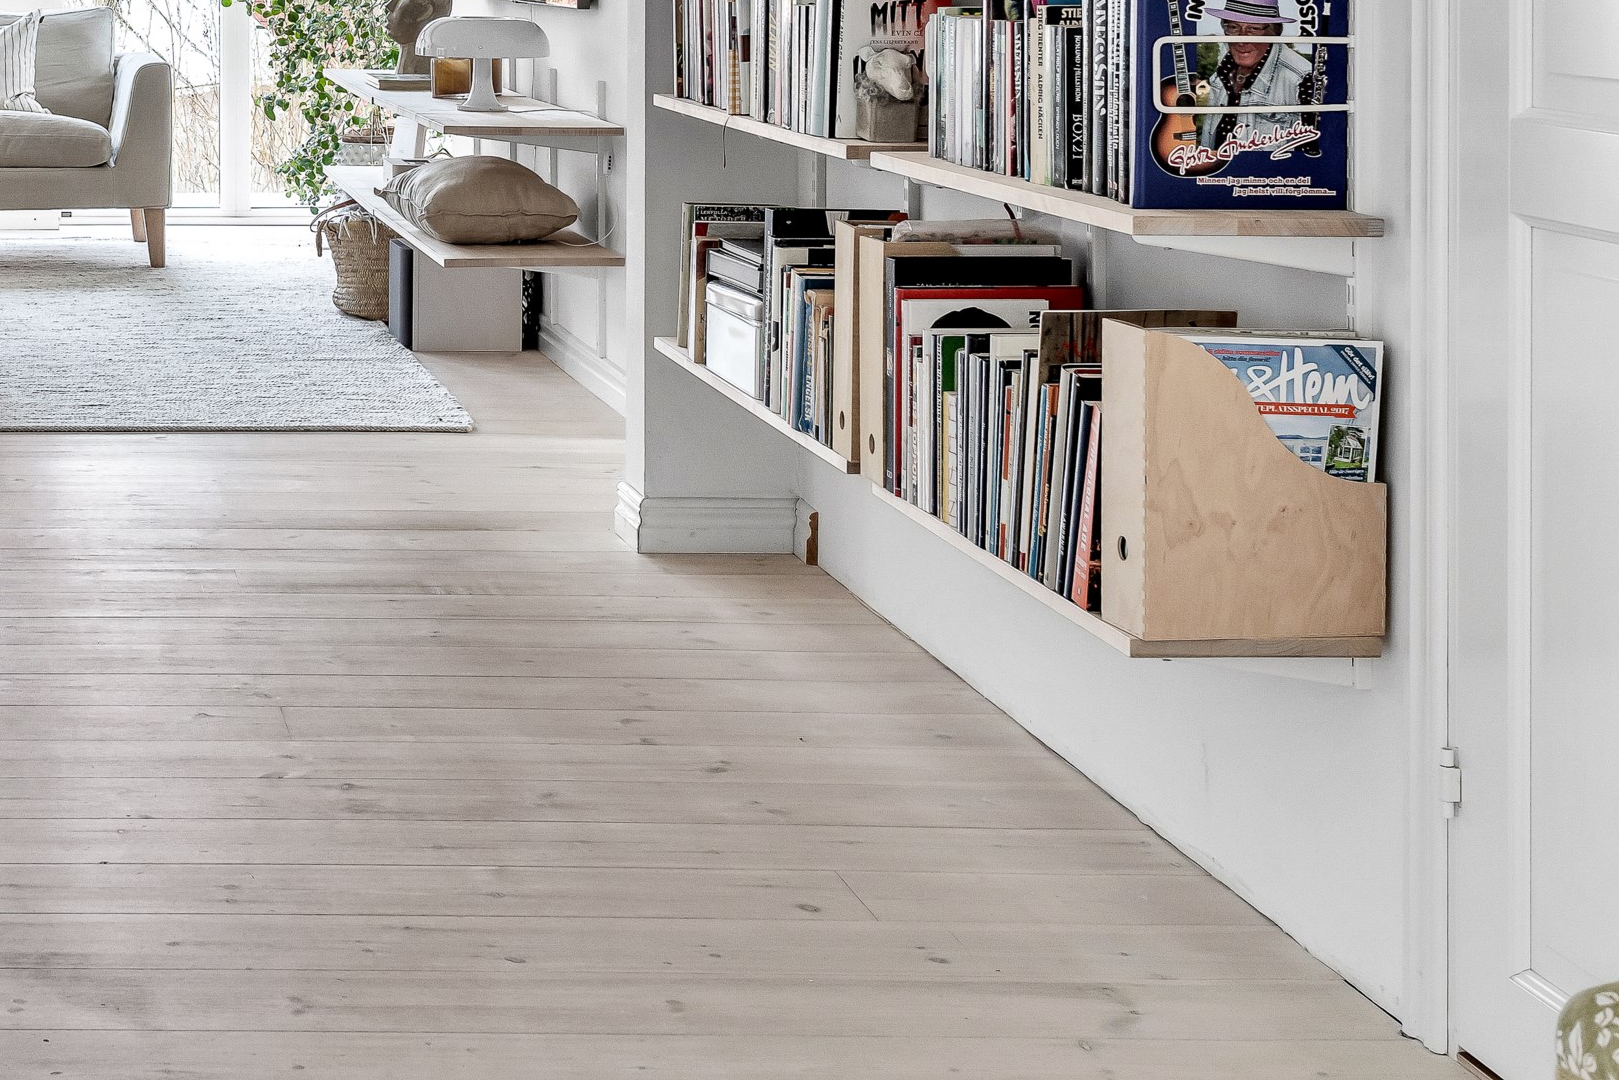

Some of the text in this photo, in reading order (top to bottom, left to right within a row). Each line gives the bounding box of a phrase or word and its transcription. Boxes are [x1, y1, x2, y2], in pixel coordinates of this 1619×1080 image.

[1061, 8, 1082, 18] STIE
[769, 13, 777, 71] ZLATAN
[1072, 114, 1082, 141] BOX
[1072, 144, 1082, 160] 21
[1197, 177, 1226, 185] Minnen
[1228, 177, 1241, 186] jag
[1234, 188, 1248, 196] jag
[1343, 346, 1356, 358] Gör
[1352, 356, 1363, 367] det
[804, 374, 812, 422] ENGELSK
[1330, 407, 1350, 415] 2017
[1083, 470, 1094, 520] GLOBAL
[1080, 524, 1088, 552] AGE
